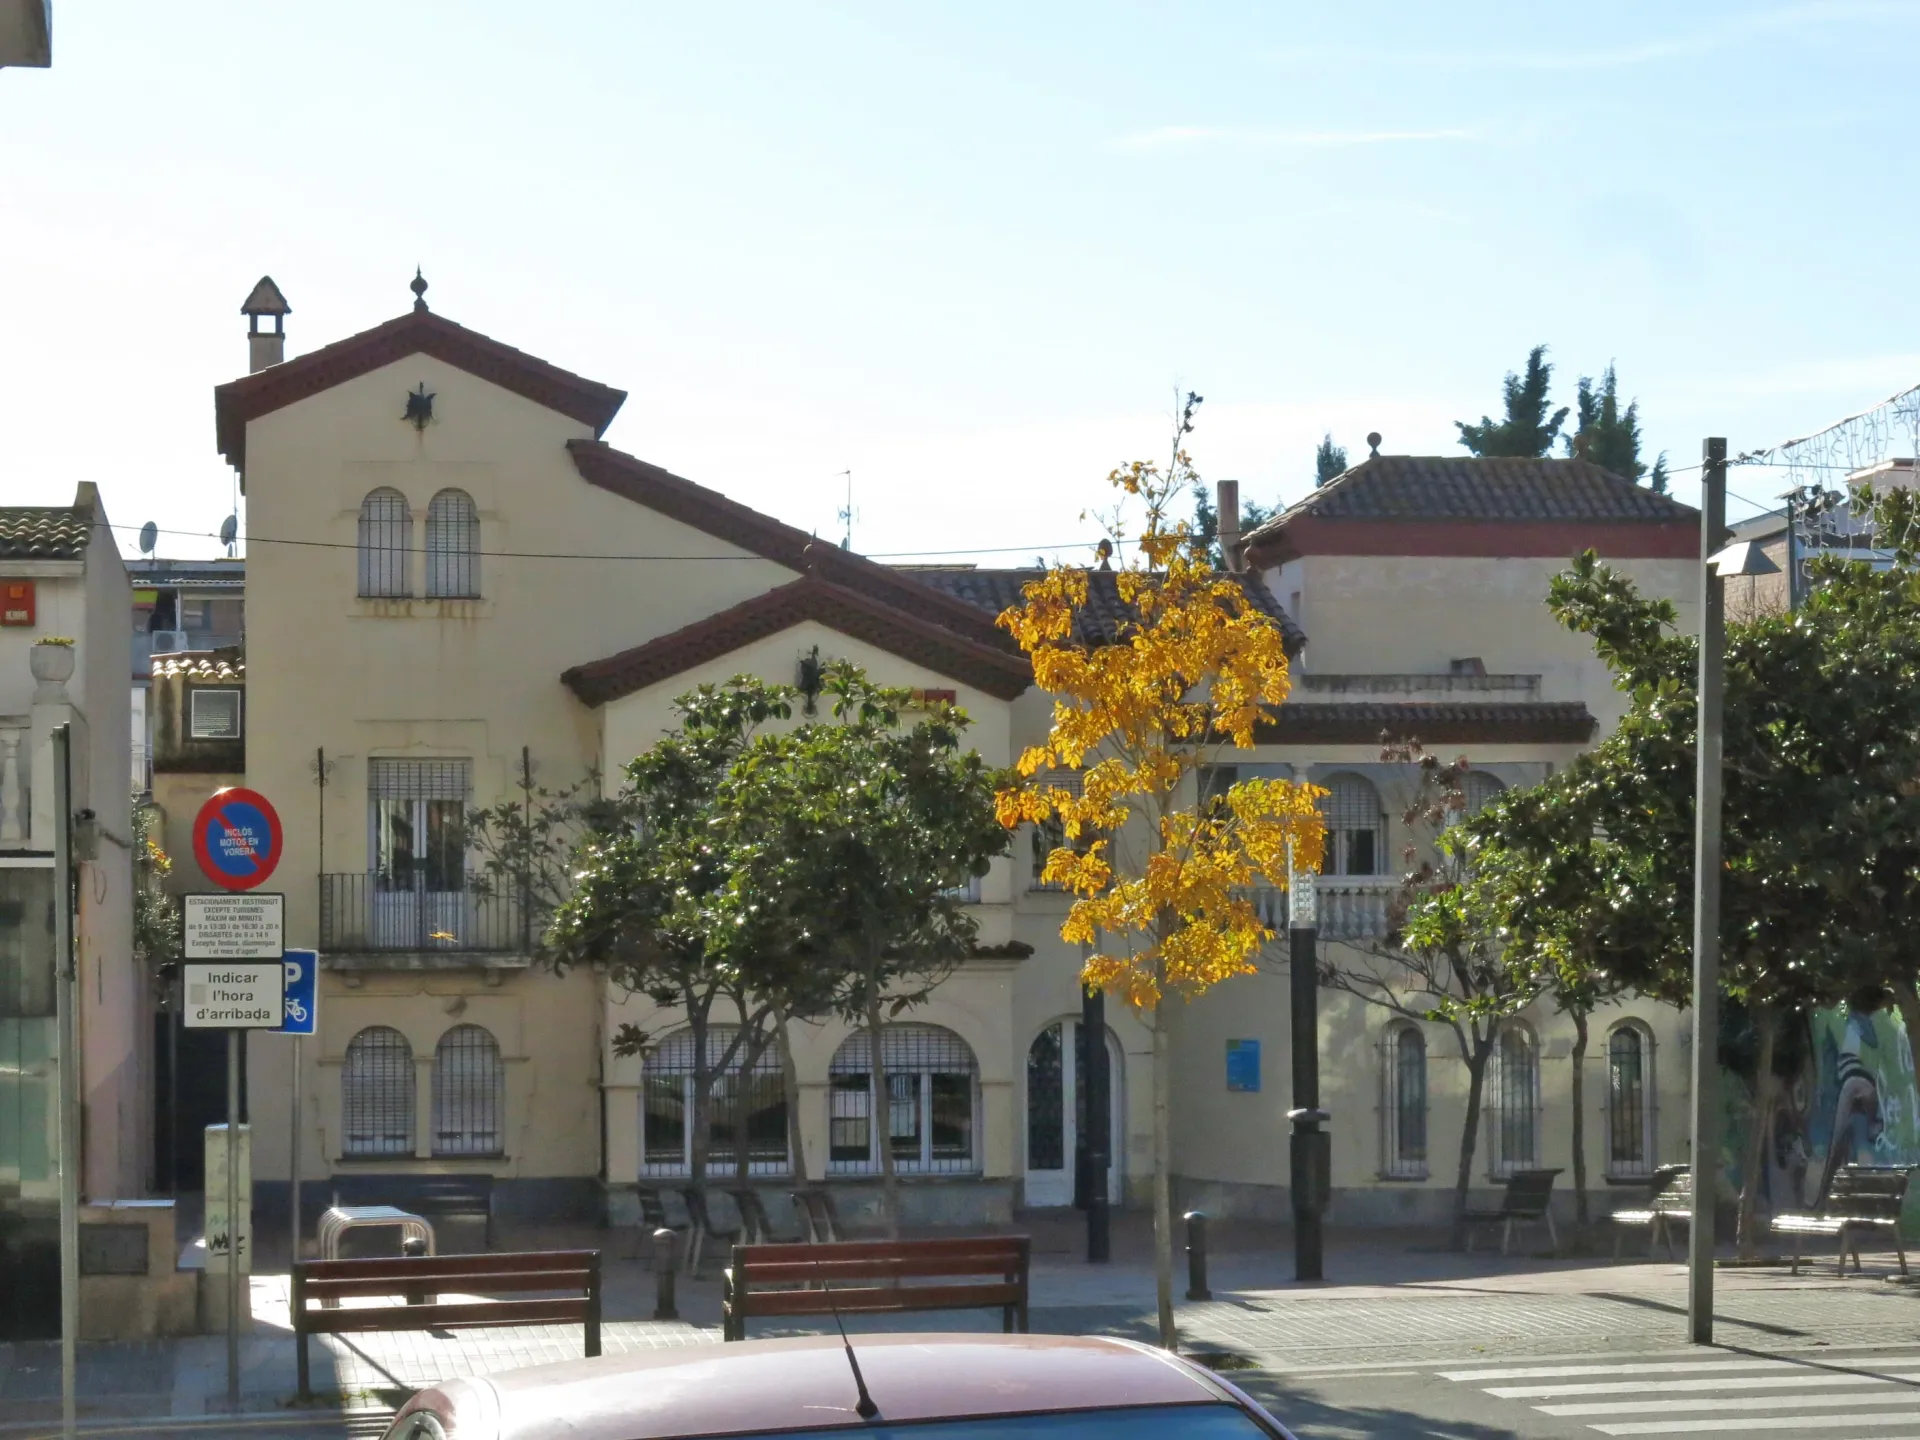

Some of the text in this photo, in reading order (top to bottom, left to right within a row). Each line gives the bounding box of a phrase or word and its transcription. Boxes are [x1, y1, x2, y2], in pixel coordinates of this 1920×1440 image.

[219, 837, 259, 847] MOTOS EN
[223, 847, 256, 856] VORERA
[188, 898, 278, 906] ESTACIONAMENT RESTRINGIT
[203, 906, 264, 914] EXCEPTE TURISMES
[208, 972, 259, 984] Indicar
[284, 962, 302, 992] P
[213, 990, 254, 1001] l'hora
[196, 1008, 271, 1020] d'arribada
